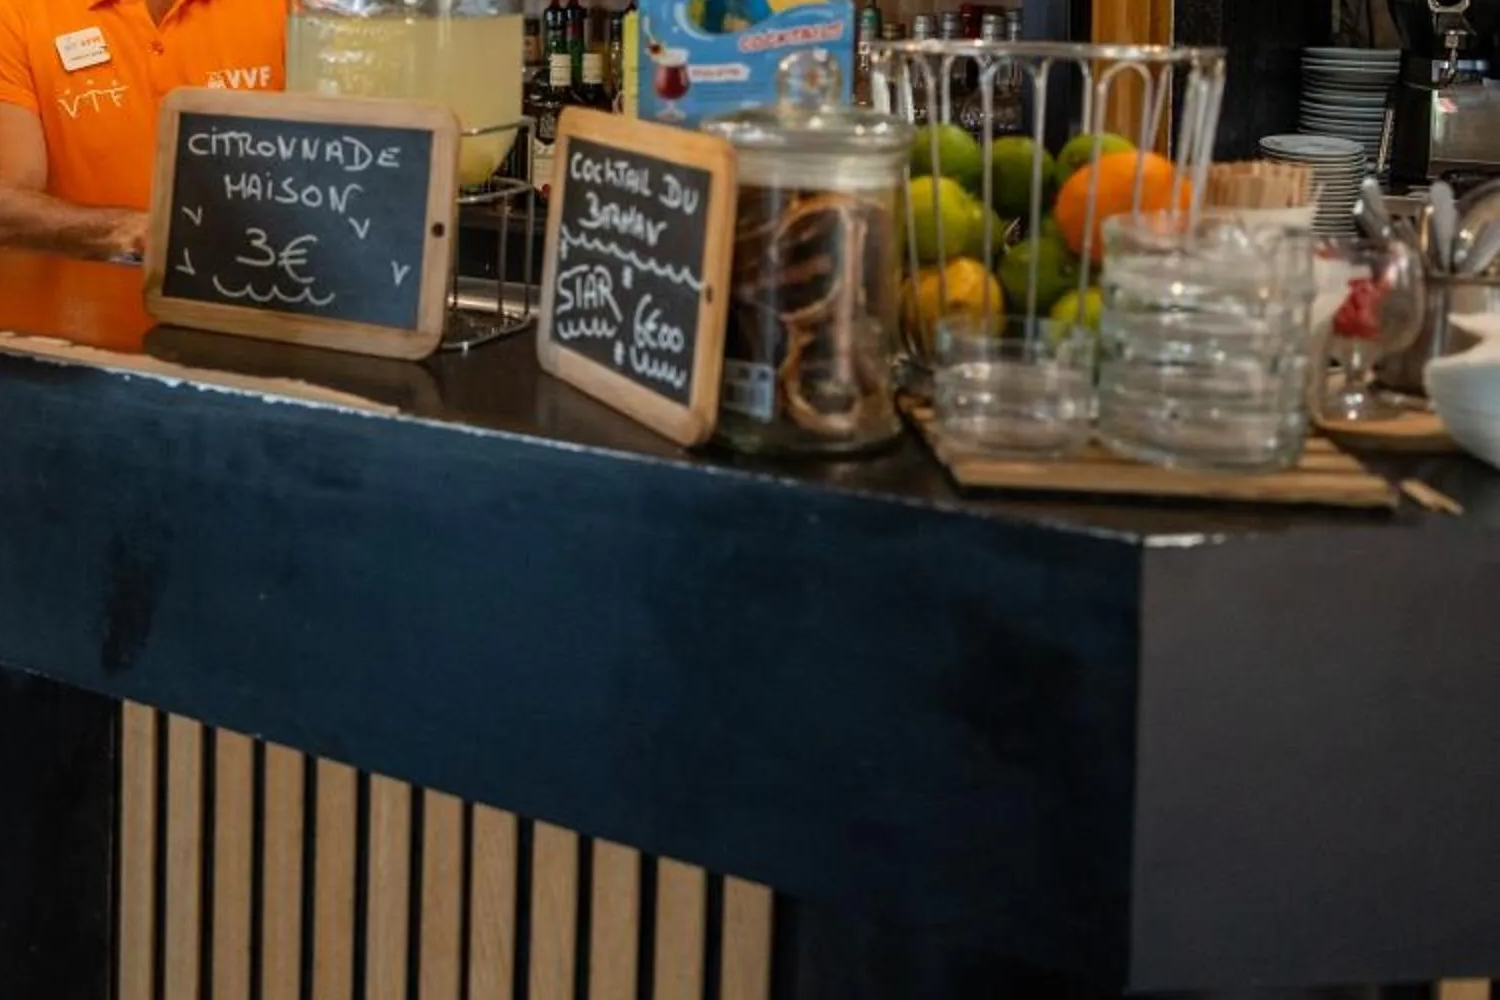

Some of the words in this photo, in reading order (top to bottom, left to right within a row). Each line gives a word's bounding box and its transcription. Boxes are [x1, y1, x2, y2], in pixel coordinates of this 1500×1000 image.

[228, 65, 271, 89] VVF
[658, 173, 699, 215] DU
[236, 227, 319, 283] 3€
[556, 264, 623, 323] STAR
